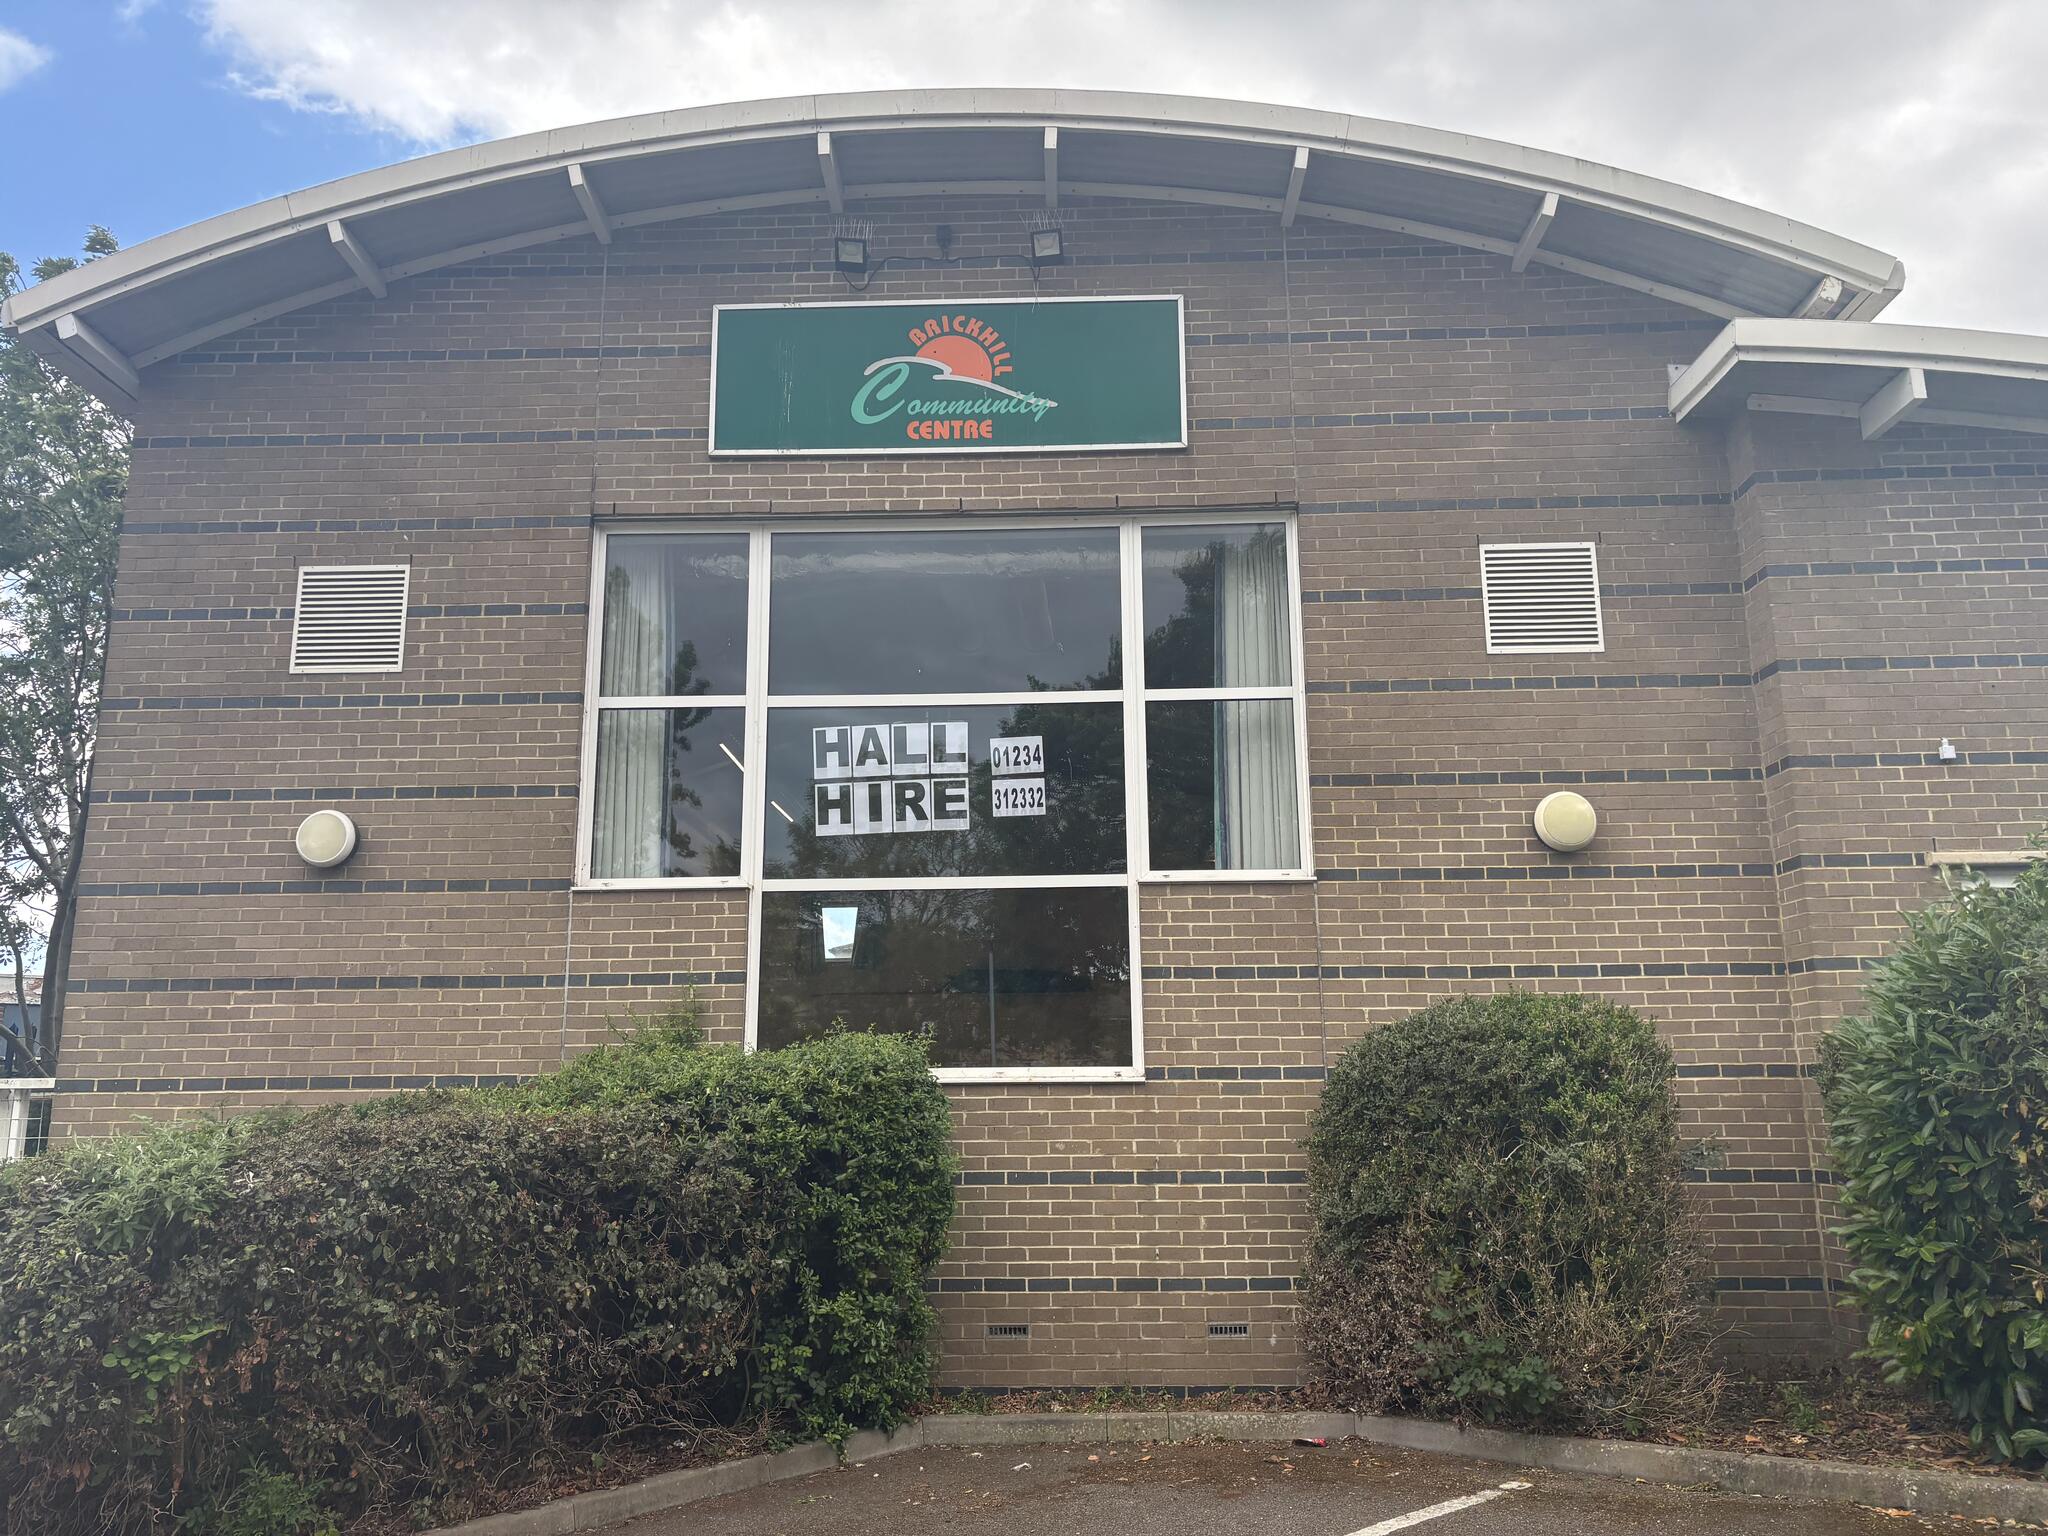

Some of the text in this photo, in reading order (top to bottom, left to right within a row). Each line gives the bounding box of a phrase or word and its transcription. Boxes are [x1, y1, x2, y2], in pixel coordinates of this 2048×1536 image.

[908, 315, 1013, 377] BRICKHILL
[851, 362, 1051, 425] Community
[907, 419, 993, 440] CENTRE
[814, 724, 967, 768] HALL
[992, 744, 1042, 768] 01234
[817, 780, 968, 825] HIRE
[994, 787, 1045, 810] 312332
